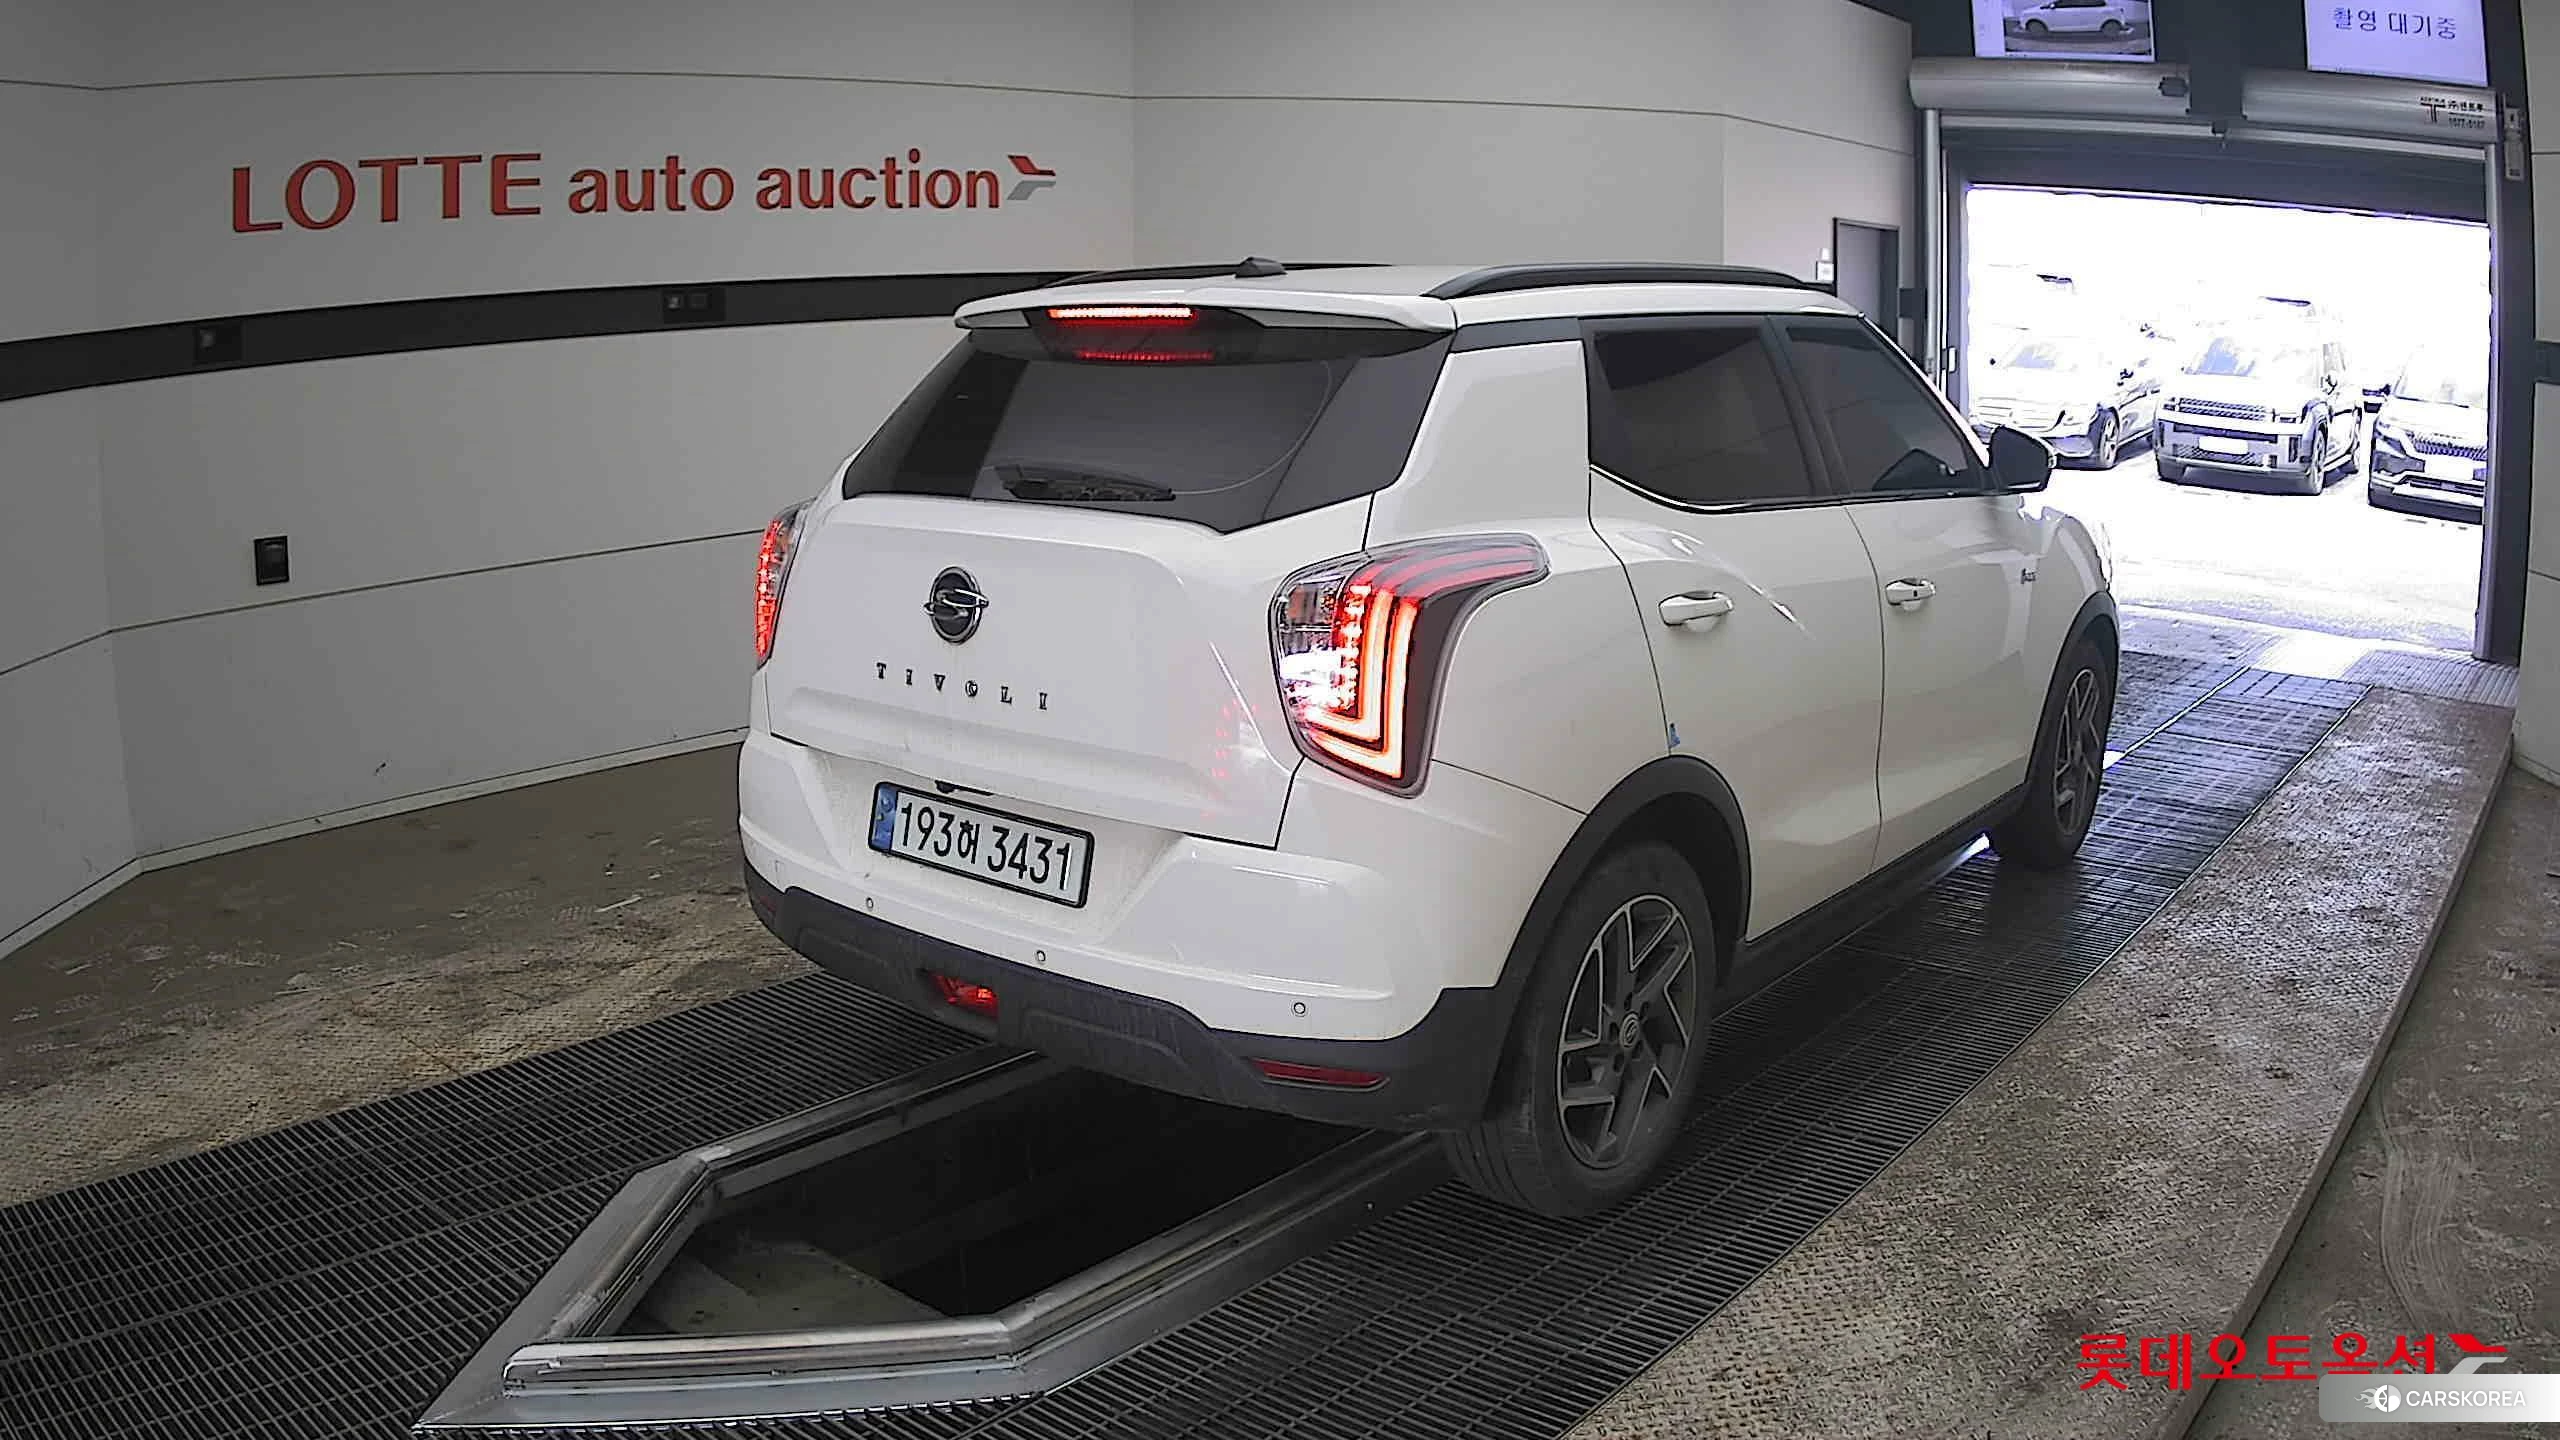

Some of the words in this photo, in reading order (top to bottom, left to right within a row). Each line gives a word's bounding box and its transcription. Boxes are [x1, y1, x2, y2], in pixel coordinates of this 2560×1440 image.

[2387, 12, 2457, 40] 대기중
[232, 152, 542, 233] LOTTE
[567, 154, 735, 215] auto
[755, 148, 1001, 210] auction
[876, 662, 1048, 710] TIVOLI
[900, 801, 981, 865] 193허
[987, 825, 1074, 890] 3431
